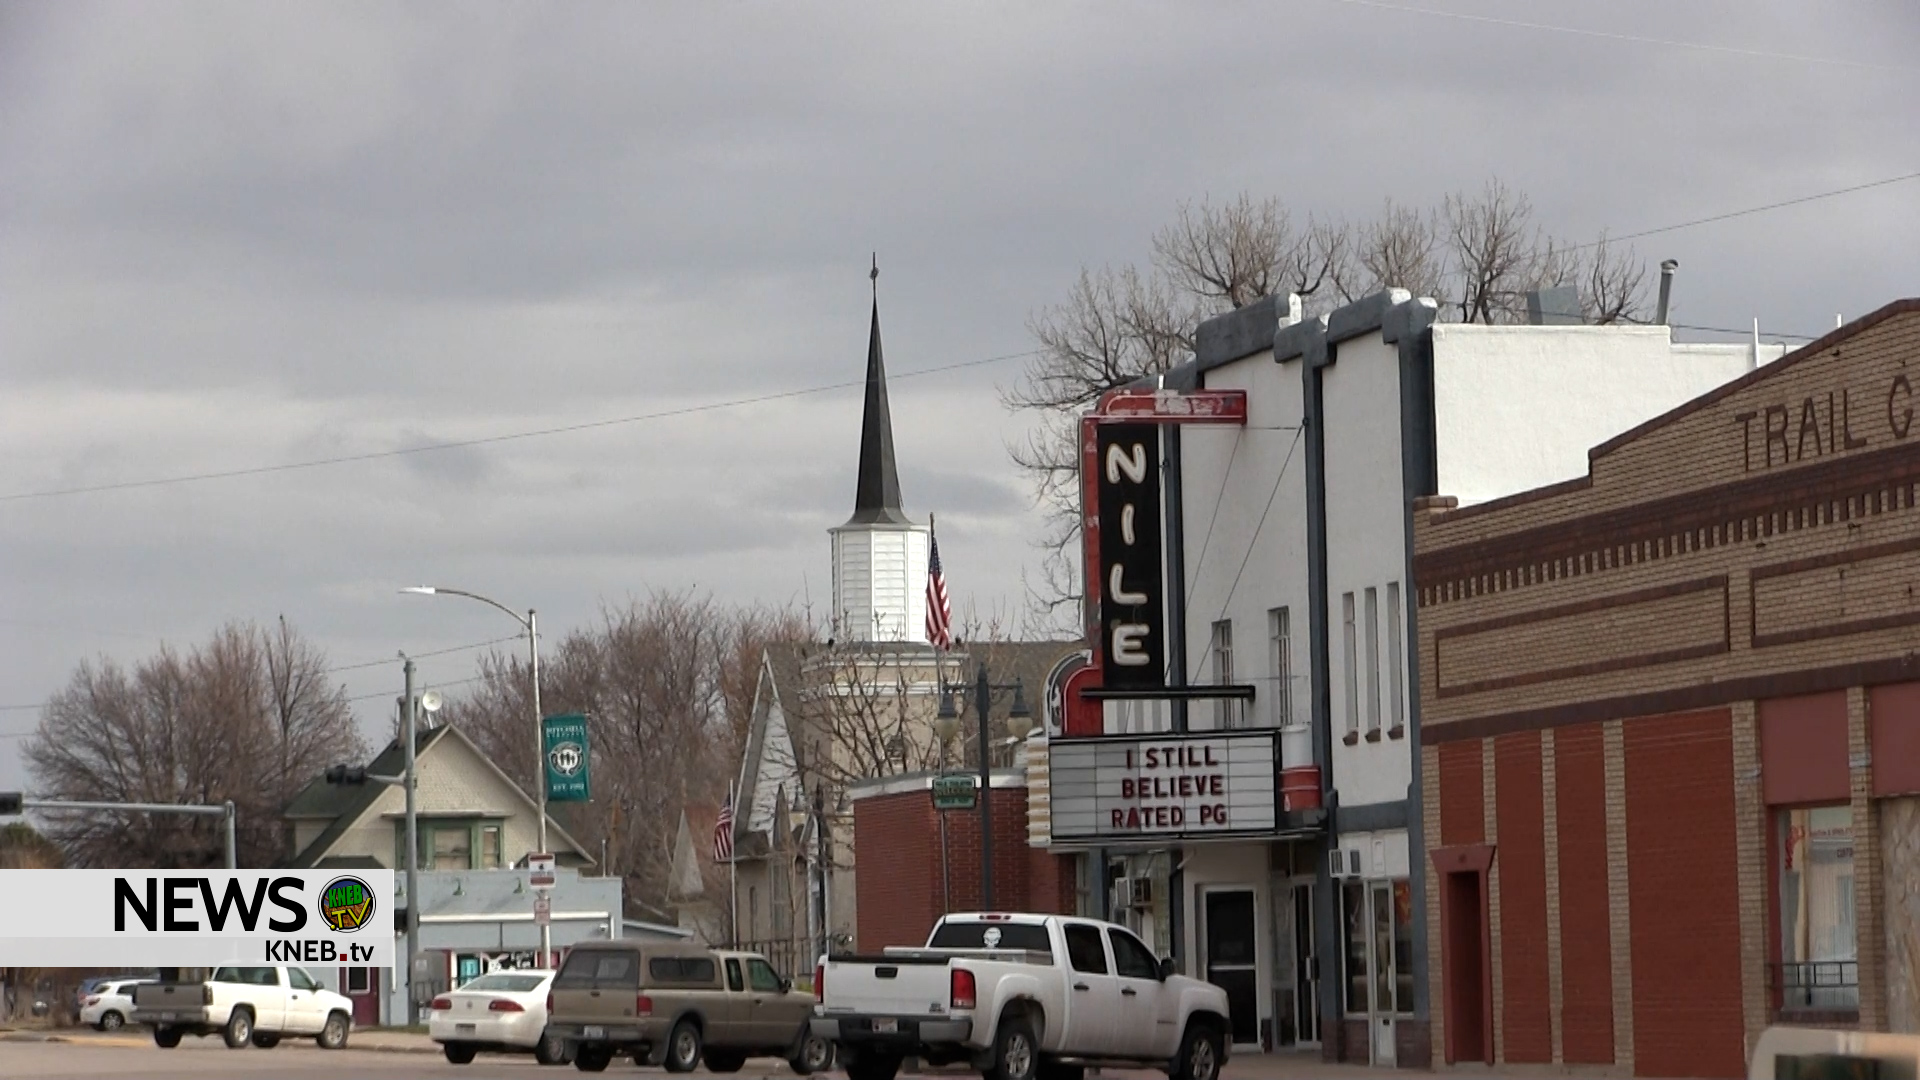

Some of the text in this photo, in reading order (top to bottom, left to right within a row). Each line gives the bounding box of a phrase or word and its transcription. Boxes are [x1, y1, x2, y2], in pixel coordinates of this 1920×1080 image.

[1735, 389, 1867, 472] TRAIL
[1105, 442, 1150, 666] NILE
[1125, 746, 1219, 769] I STILL
[1121, 775, 1224, 799] BELIEVE
[1111, 805, 1227, 828] RATED PG
